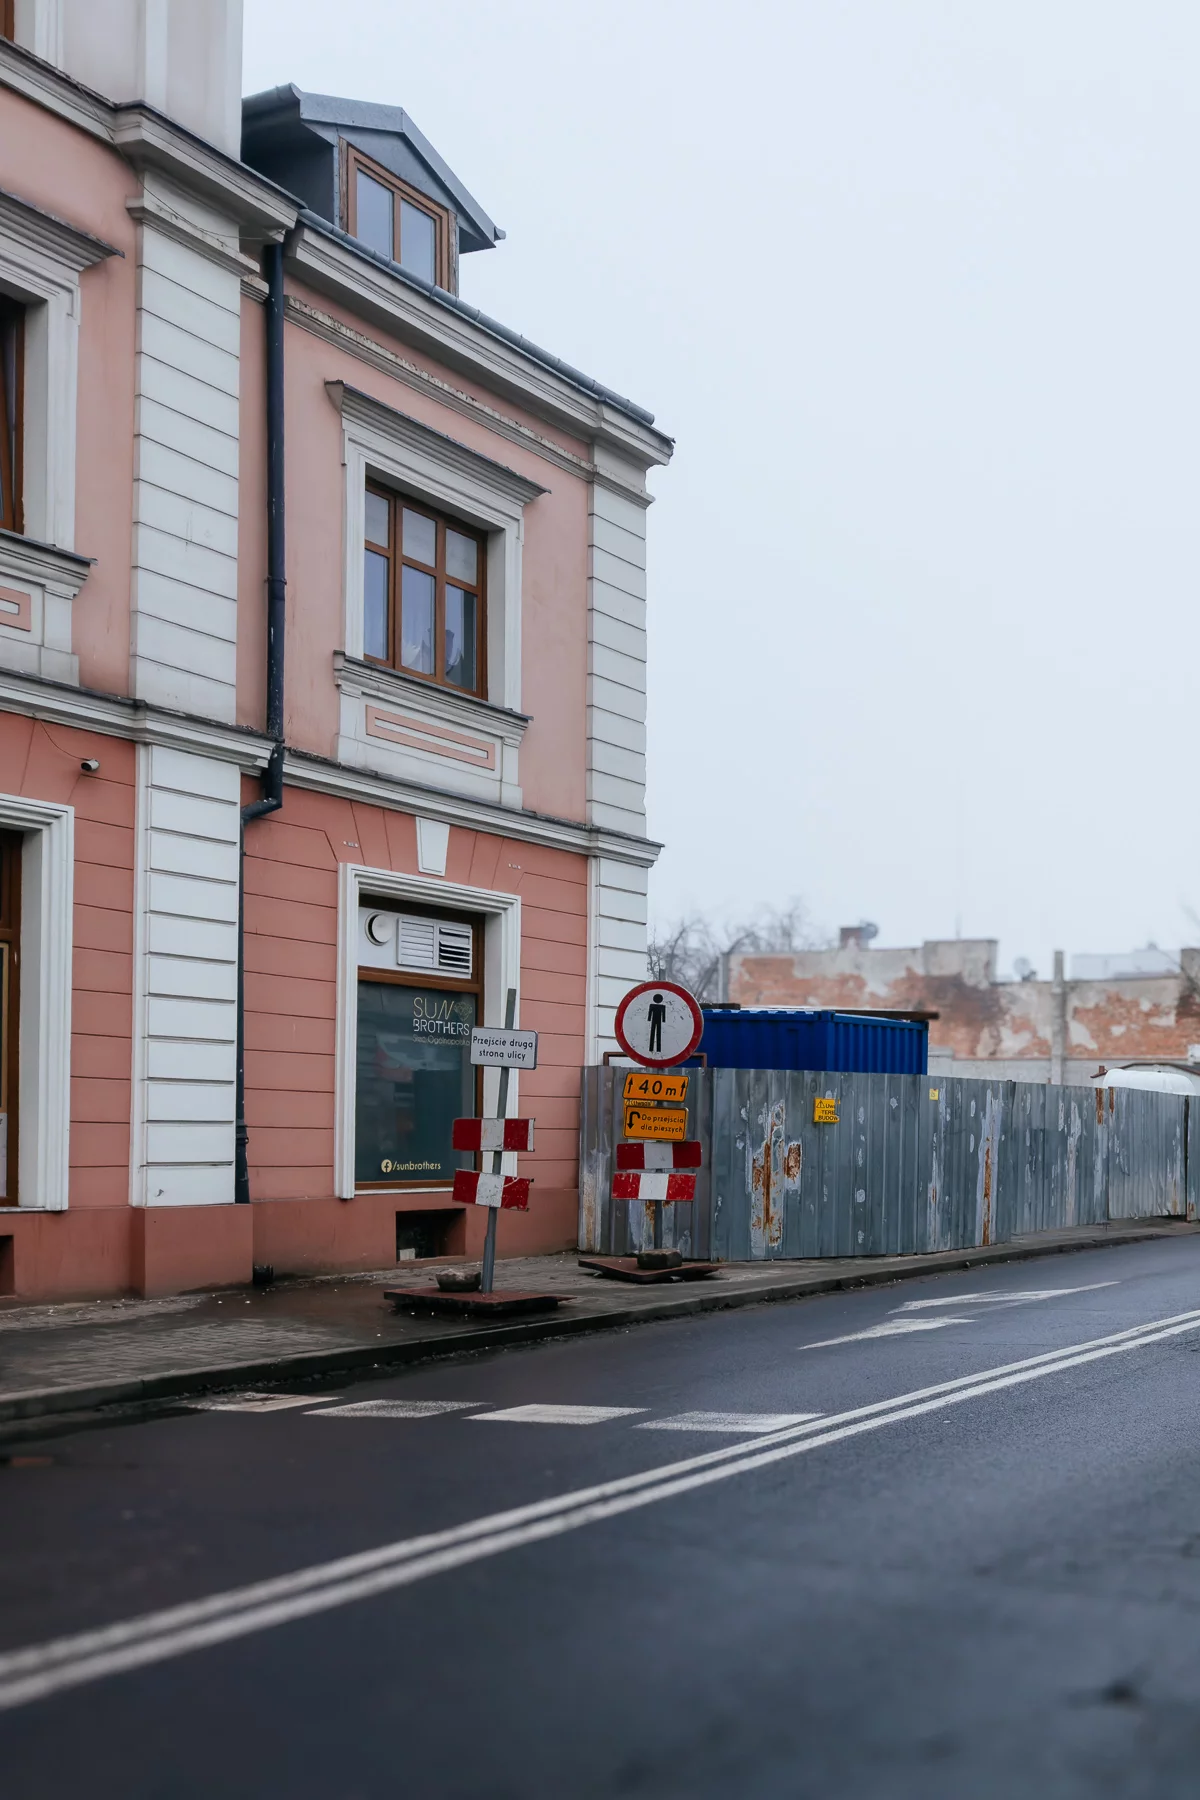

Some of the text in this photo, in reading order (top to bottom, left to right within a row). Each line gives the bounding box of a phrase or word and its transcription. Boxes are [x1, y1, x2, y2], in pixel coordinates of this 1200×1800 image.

[413, 997, 454, 1020] SUN
[413, 1019, 470, 1035] BROTHERS
[472, 1035, 507, 1047] Przejście
[507, 1049, 526, 1061] ulicy
[639, 1079, 676, 1095] 40 m
